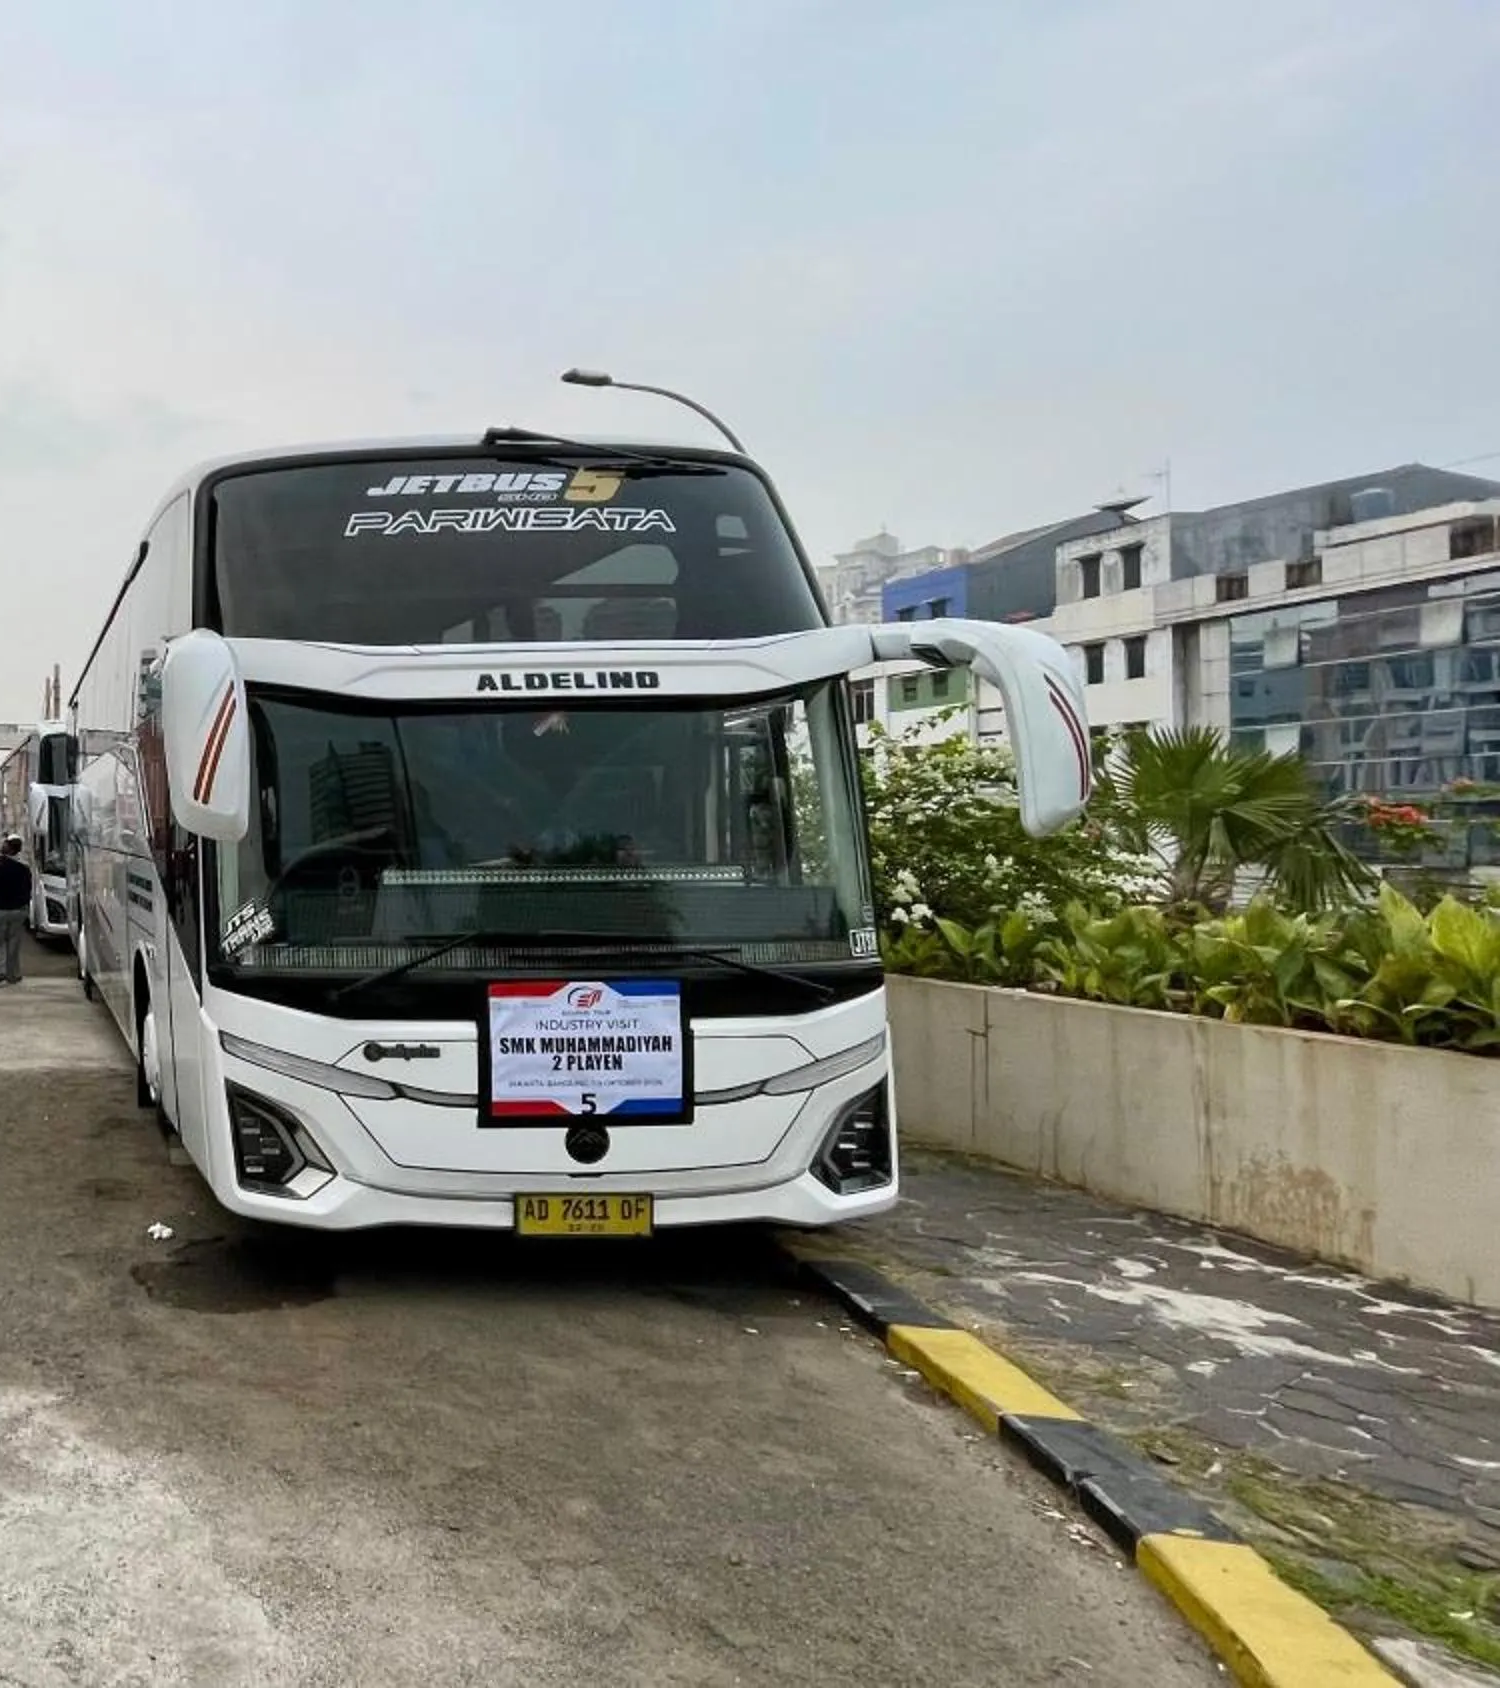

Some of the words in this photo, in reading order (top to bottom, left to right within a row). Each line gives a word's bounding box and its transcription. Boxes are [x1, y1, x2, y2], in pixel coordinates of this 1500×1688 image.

[367, 473, 567, 496] JETBUS
[564, 466, 626, 501] 5
[344, 507, 677, 537] PARIWISATA
[535, 1019, 602, 1031] INDUSTRY
[607, 1018, 640, 1029] VISIT
[499, 1036, 536, 1054] SMK
[541, 1035, 673, 1053] MUHAMMADIYAH
[552, 1055, 563, 1071] 2
[567, 1054, 623, 1070] PLAYEN
[581, 1093, 597, 1114] 5
[525, 1200, 549, 1220] AD
[562, 1200, 610, 1220] 7611
